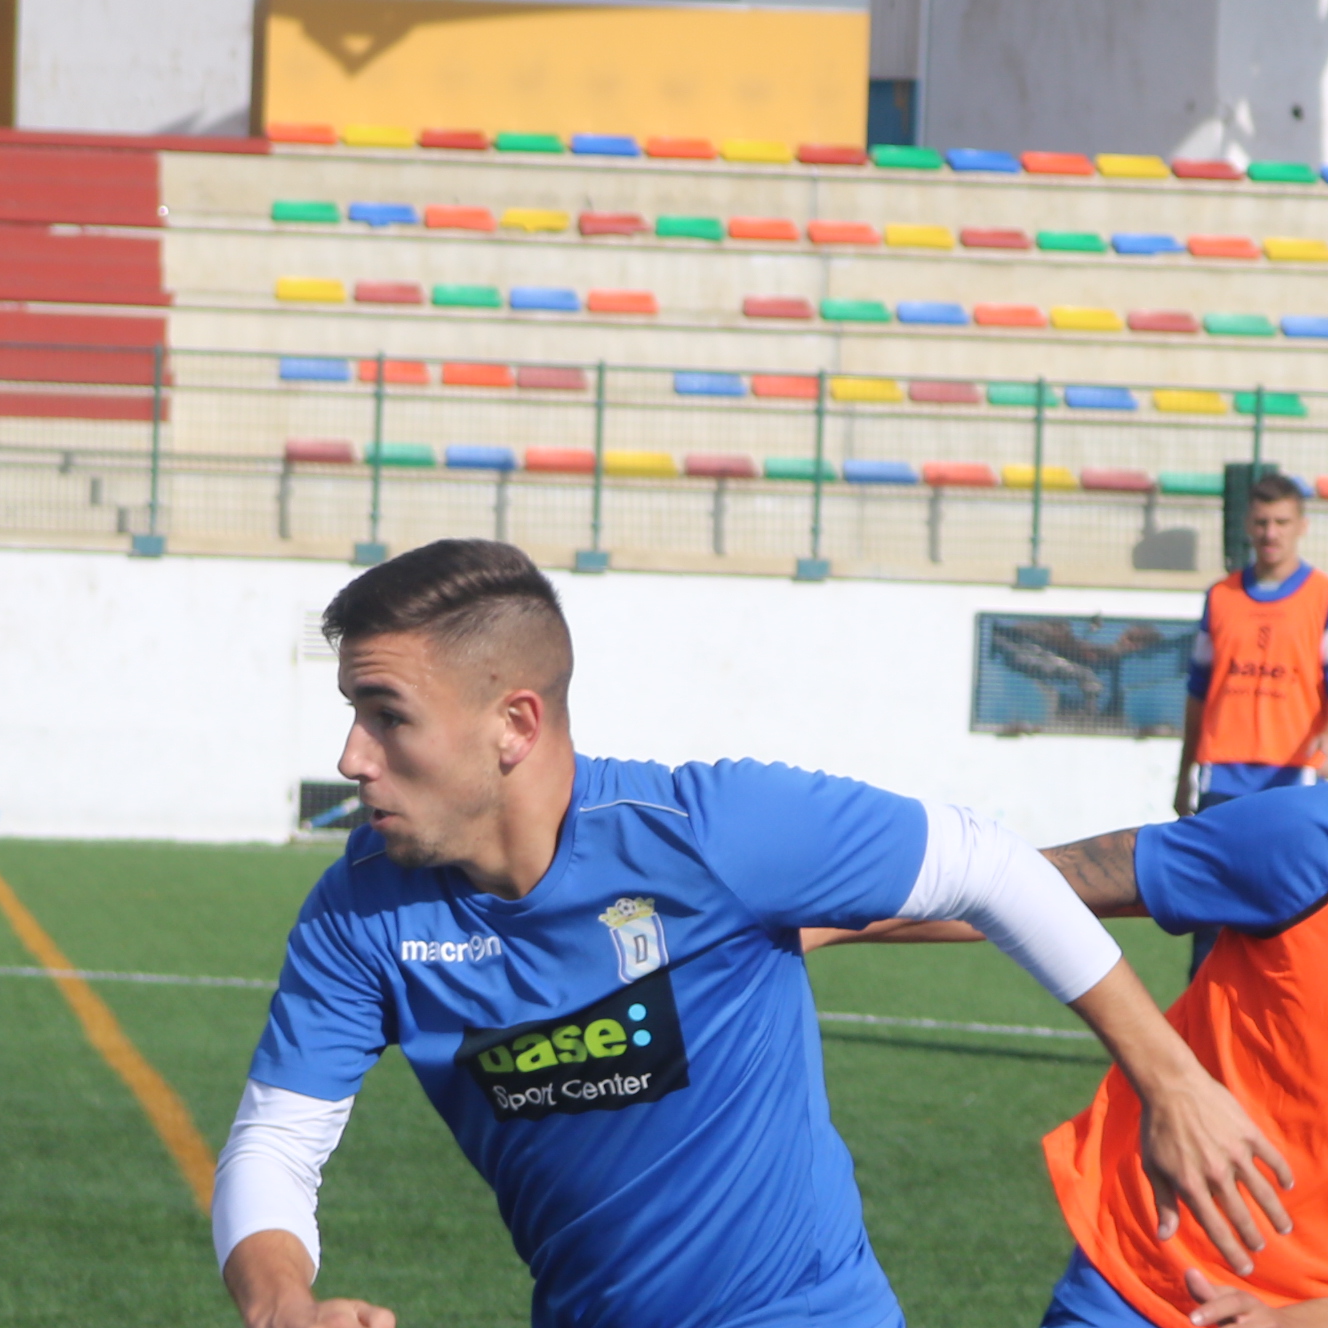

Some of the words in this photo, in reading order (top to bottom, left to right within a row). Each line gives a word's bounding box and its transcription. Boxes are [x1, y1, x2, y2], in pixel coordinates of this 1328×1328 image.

[401, 933, 502, 964] macron
[492, 1082, 557, 1111] Sport
[561, 1072, 652, 1101] Center
